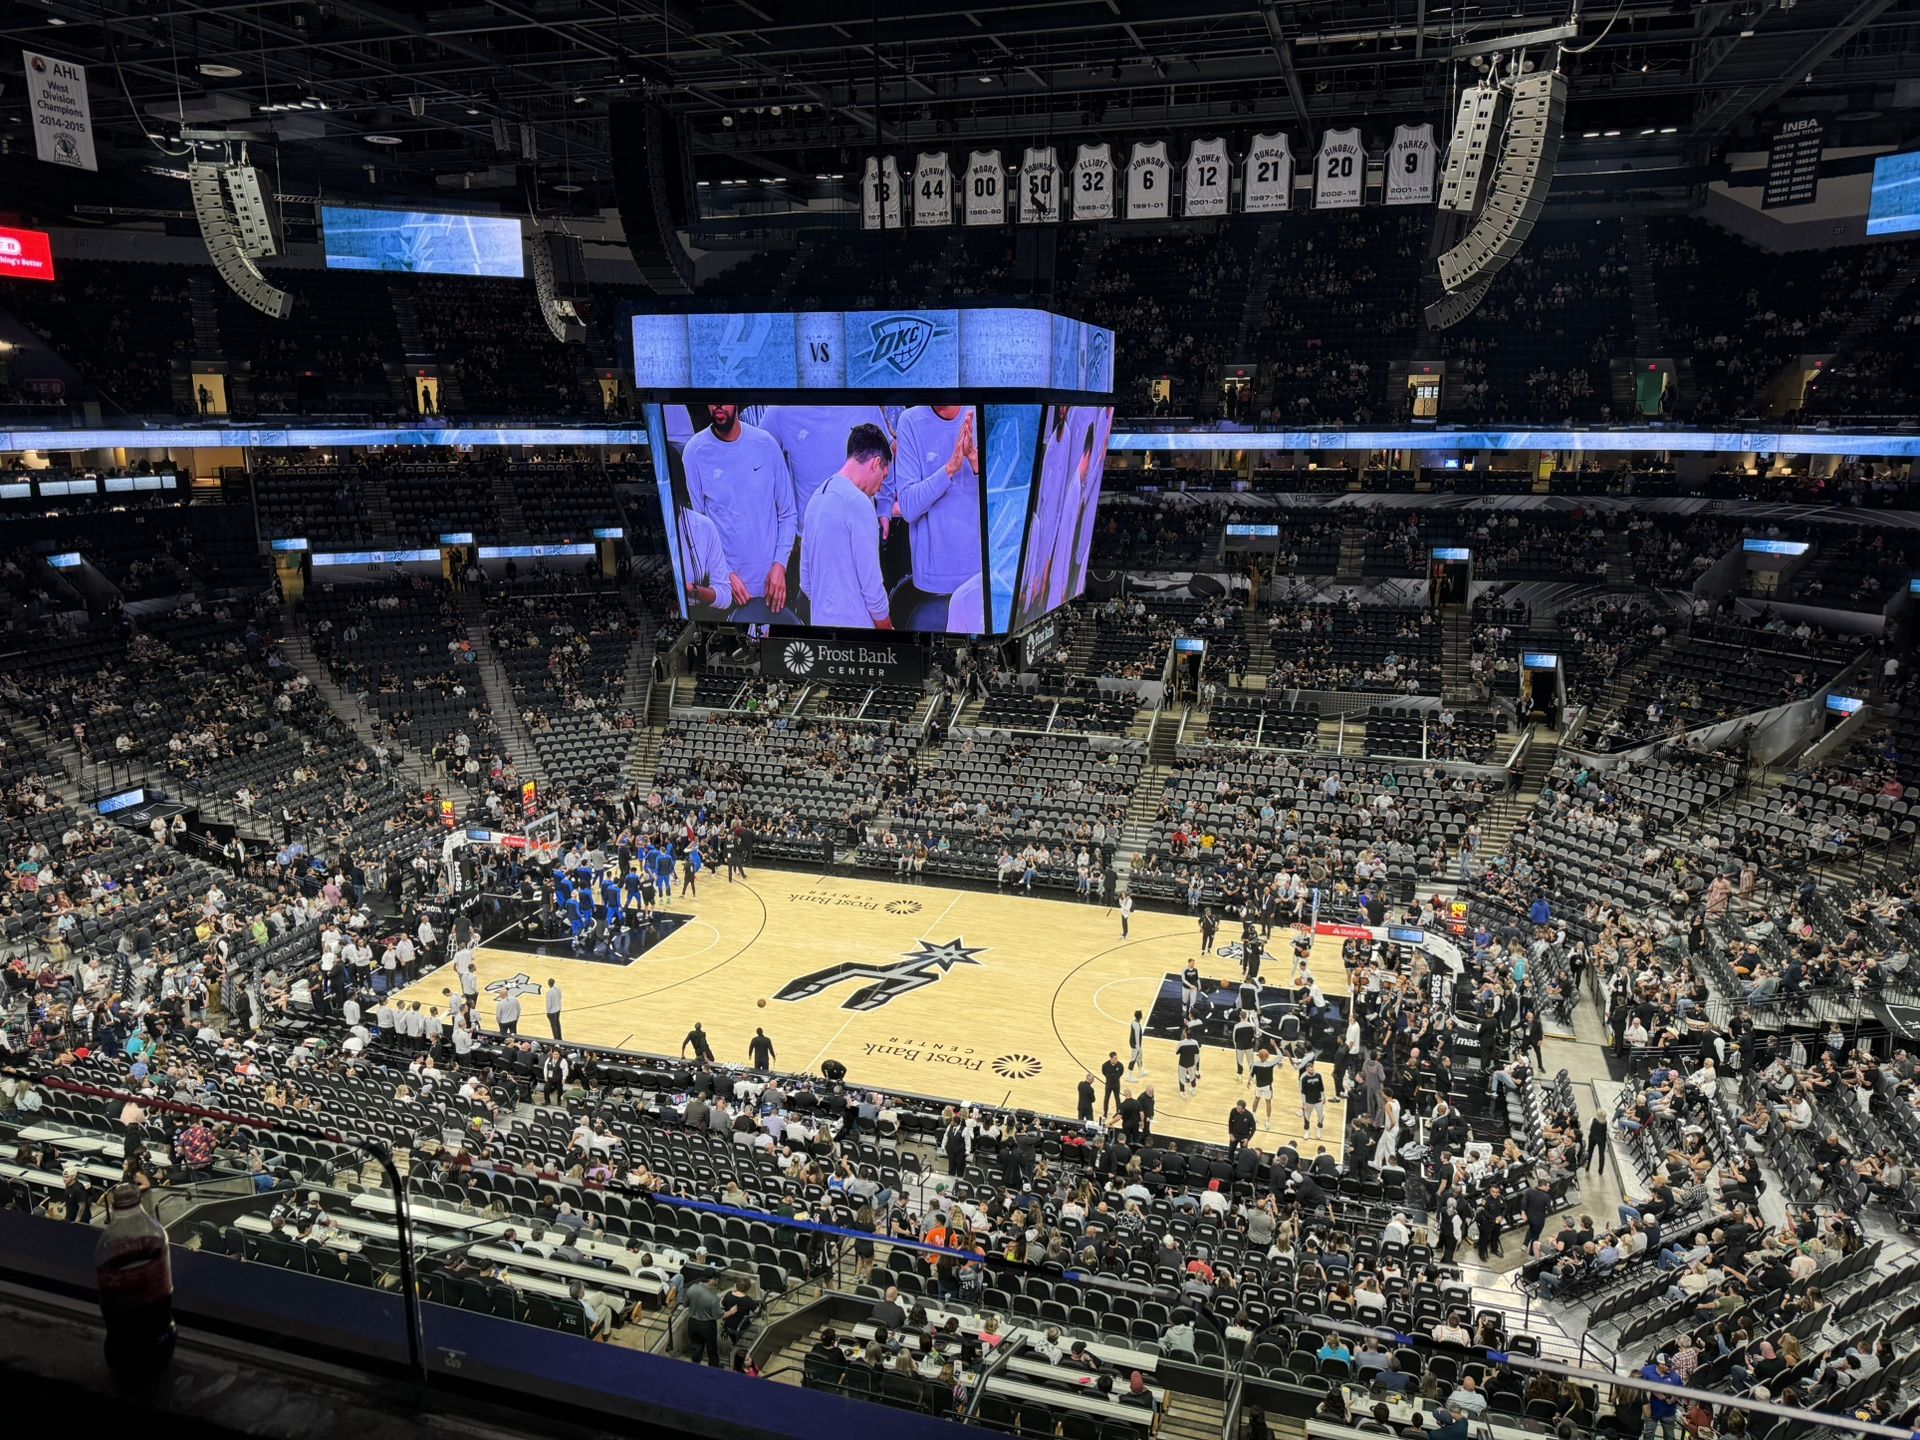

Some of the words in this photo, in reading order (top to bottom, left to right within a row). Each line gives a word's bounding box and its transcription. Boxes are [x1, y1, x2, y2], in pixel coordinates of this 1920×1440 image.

[53, 63, 80, 81] AHL
[47, 80, 69, 93] West
[42, 90, 76, 106] Division
[37, 100, 83, 118] Champions
[39, 115, 85, 133] 2014-2015
[1788, 118, 1818, 132] NBA
[1253, 149, 1285, 161] DUNCAN
[1324, 144, 1359, 157] GINOBILI
[1398, 140, 1429, 152] PARKER
[1079, 159, 1108, 170] ELLIOTT
[1133, 157, 1166, 171] JOHNSON
[1195, 154, 1221, 165] BOWEN
[1327, 156, 1353, 178] 20
[1405, 153, 1418, 174] 9
[920, 167, 945, 178] GERVIN
[973, 164, 998, 175] MOORE
[1024, 163, 1056, 175] ROBINSON
[1198, 166, 1217, 186] 12
[1257, 161, 1279, 182] 21
[974, 177, 996, 197] 00
[1029, 175, 1050, 195] 50
[1082, 171, 1104, 191] 32
[1143, 170, 1154, 190] 6
[921, 180, 944, 199] 44
[809, 342, 830, 363] VS
[871, 325, 920, 364] OKC
[817, 645, 856, 662] Frost
[858, 647, 898, 665] Bank
[828, 666, 885, 677] CENTER
[788, 894, 832, 905] Bank
[834, 899, 879, 910] Frost
[861, 1042, 920, 1061] Bank
[889, 1036, 975, 1054] CENTER
[926, 1052, 986, 1071] Frost
